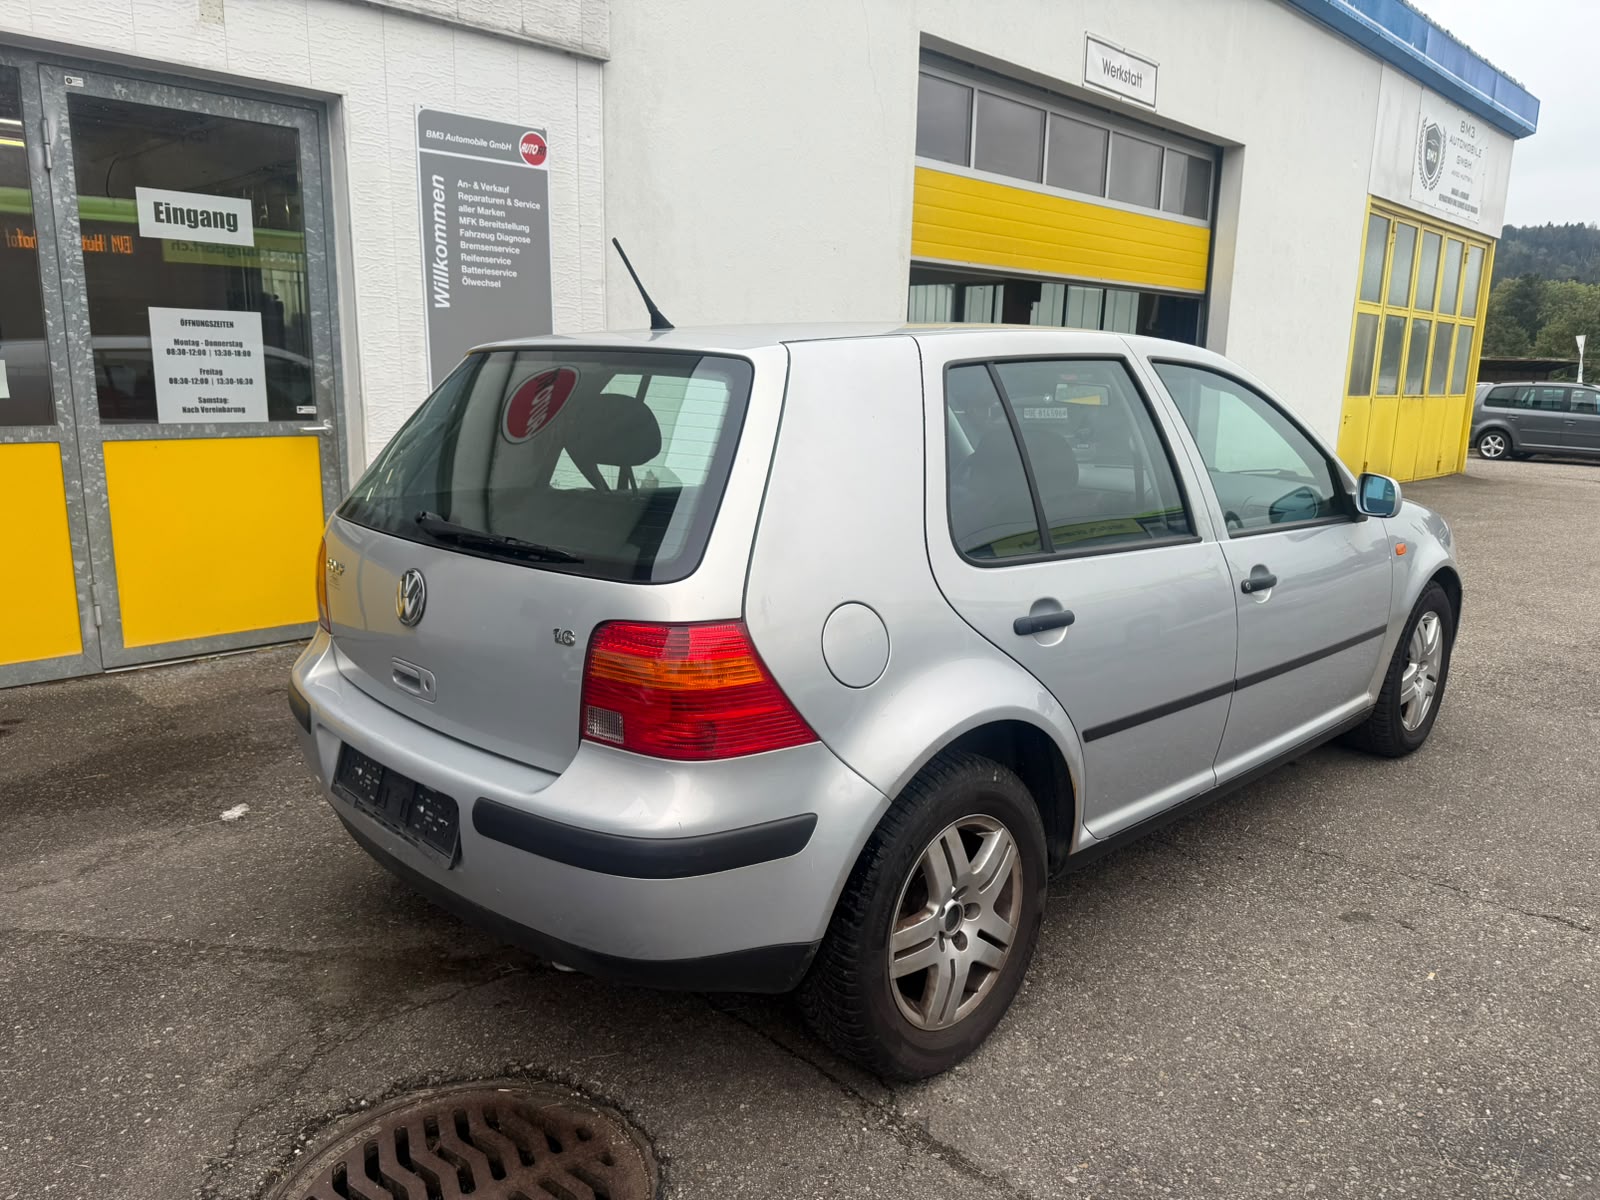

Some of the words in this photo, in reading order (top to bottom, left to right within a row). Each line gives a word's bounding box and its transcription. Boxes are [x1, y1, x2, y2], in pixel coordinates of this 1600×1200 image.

[1102, 57, 1142, 88] Werkstatt
[426, 130, 444, 140] BM3
[445, 133, 488, 147] Automobile
[489, 140, 512, 151] GmbH
[1449, 135, 1482, 158] AUTOMOBILE
[457, 179, 471, 188] An-
[473, 181, 479, 189] &
[481, 182, 510, 194] Verkauf
[458, 192, 505, 206] Reparaturen
[506, 198, 512, 206] &
[514, 199, 541, 210] Service
[153, 201, 239, 233] Eingang
[458, 205, 475, 214] aller
[477, 207, 506, 217] Marken
[459, 217, 477, 226] MFK
[479, 219, 530, 233] Bereitstellung
[432, 174, 450, 308] Willkommen
[460, 229, 495, 241] Fahrzeug
[496, 232, 531, 245] Diagnose
[460, 241, 520, 255] Bremsenservice
[461, 253, 512, 265] Reifenservice
[461, 265, 517, 278] Batterieservice
[462, 276, 501, 288] Ölwechsel
[180, 318, 234, 328] ÖFFNUNGSZEITEN
[174, 339, 200, 347] Montag
[205, 340, 243, 349] Donnerstag
[166, 348, 207, 357] 08:30-12:00
[199, 368, 223, 376] Freitag
[216, 378, 253, 386] 13:30-16:30
[182, 406, 200, 414] Nach
[200, 406, 246, 414] Vereinbarung
